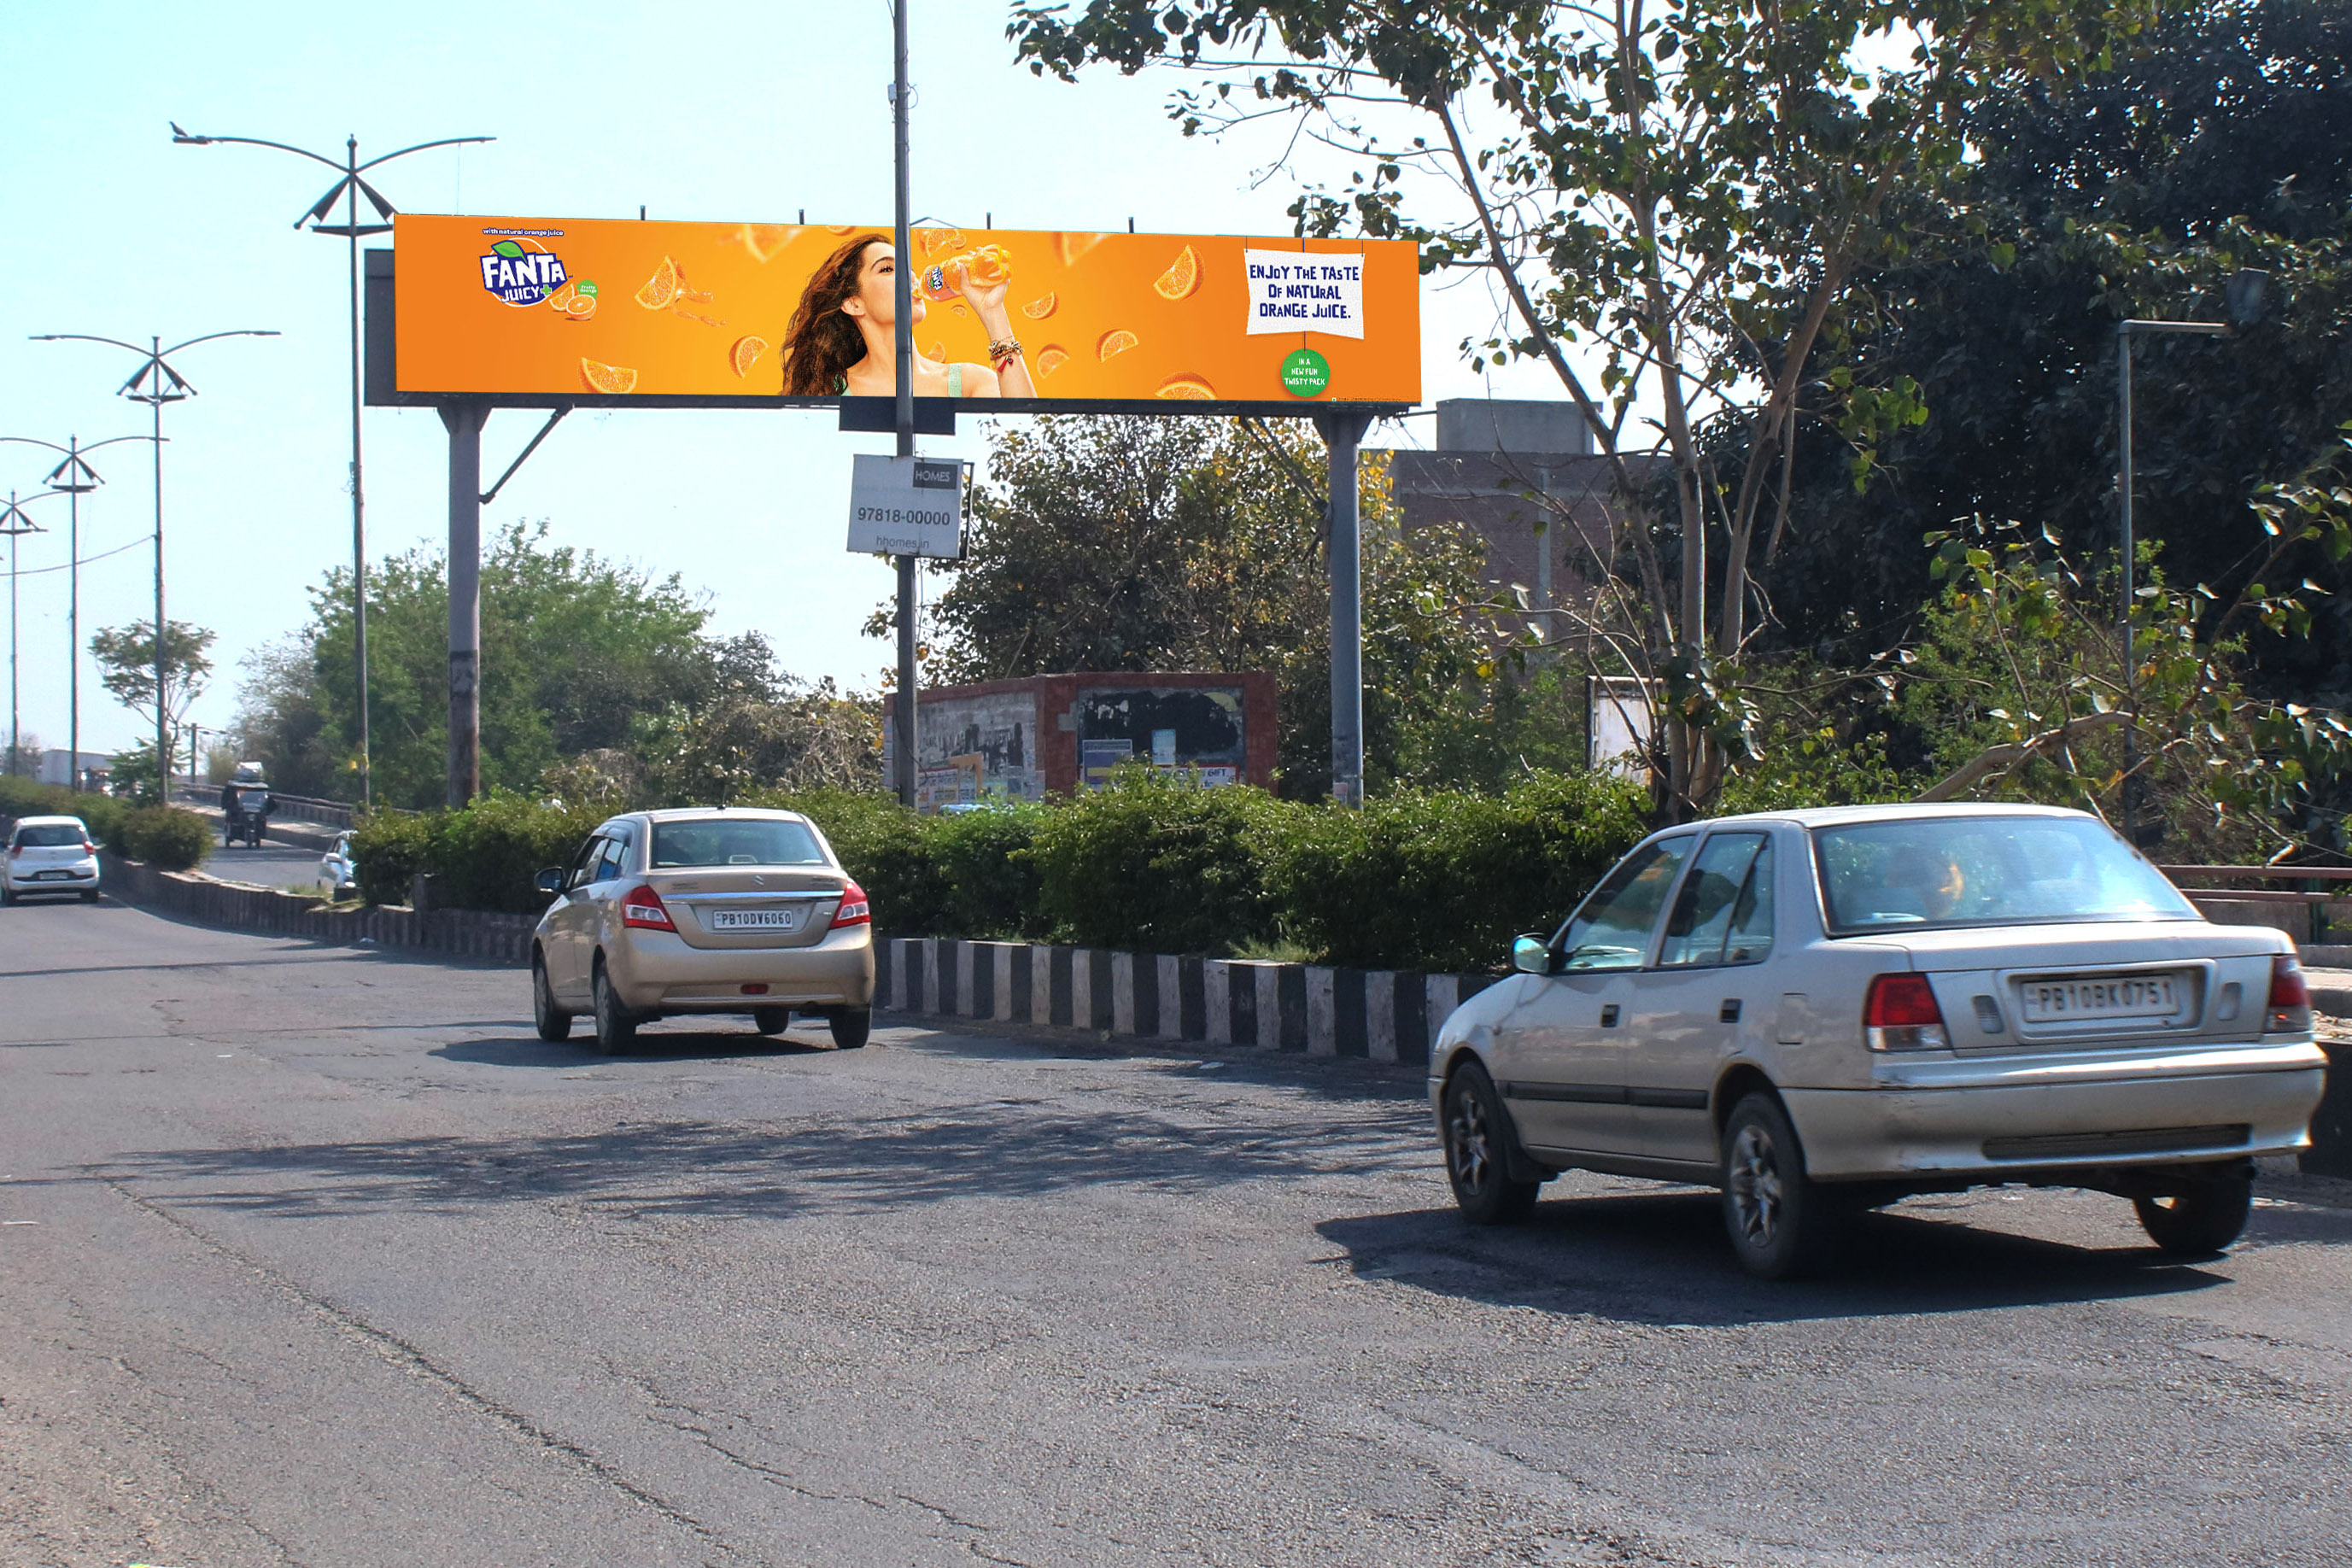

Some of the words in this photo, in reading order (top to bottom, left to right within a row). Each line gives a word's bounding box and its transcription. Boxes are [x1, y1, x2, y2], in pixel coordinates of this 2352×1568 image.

[547, 228, 564, 237] juice
[481, 255, 566, 289] FANTA
[1249, 265, 1290, 279] ENJOY
[1294, 266, 1317, 280] THE
[1321, 266, 1360, 280] TASTE
[1268, 284, 1283, 298] OF
[1286, 284, 1342, 300] NATURAL
[1260, 302, 1308, 318] ORANGE
[1312, 304, 1351, 319] JUICE.
[915, 471, 951, 483] HOMES
[857, 507, 951, 525] 97818-00000
[722, 913, 791, 925] PB10DV6060
[2039, 981, 2172, 1012] PB10BK0751
